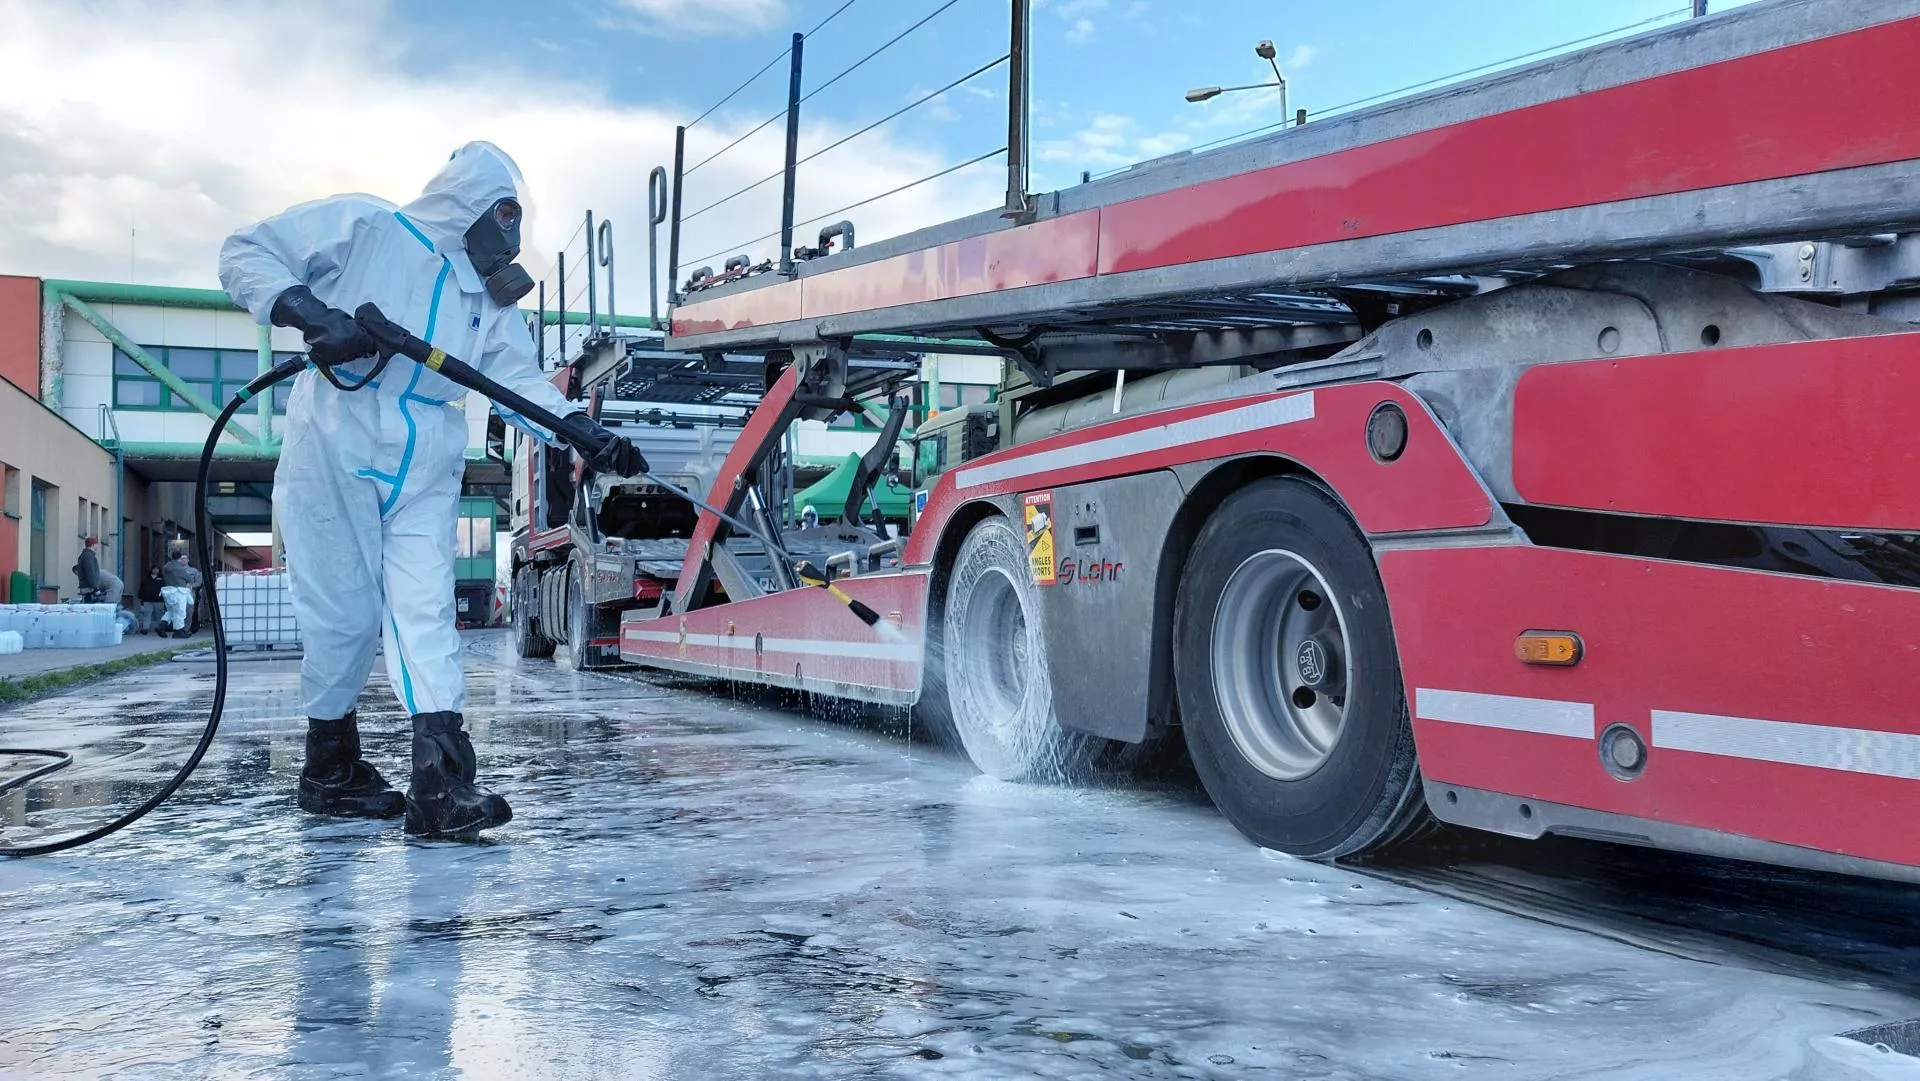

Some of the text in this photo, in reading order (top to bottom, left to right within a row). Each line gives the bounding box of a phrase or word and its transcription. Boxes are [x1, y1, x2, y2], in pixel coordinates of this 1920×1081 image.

[1025, 493, 1051, 504] ATTENTION
[1032, 556, 1051, 566] ANGLES
[1078, 558, 1123, 583] Lohr
